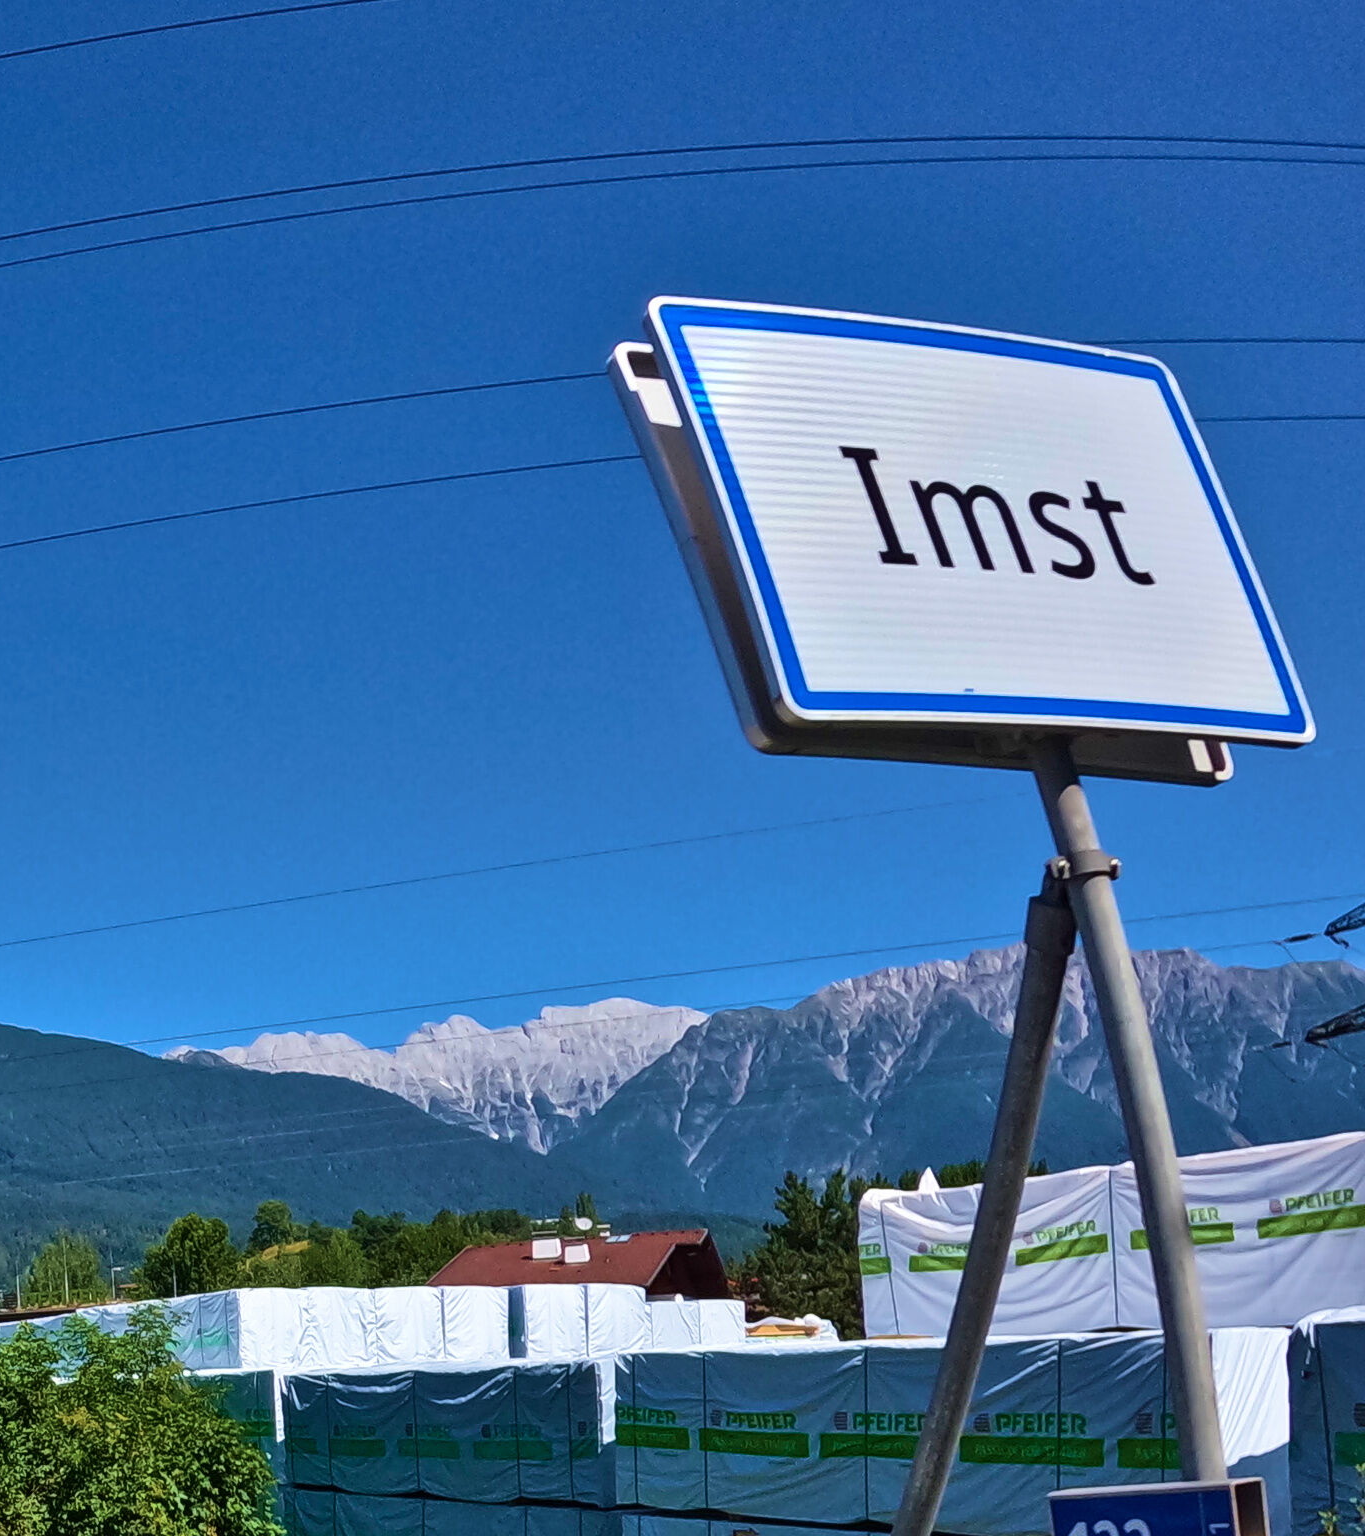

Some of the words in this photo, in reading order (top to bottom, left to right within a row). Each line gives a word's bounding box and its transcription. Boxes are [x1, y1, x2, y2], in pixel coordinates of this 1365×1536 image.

[839, 446, 1155, 586] Imst
[1286, 1188, 1354, 1212] PFEIFER
[725, 1411, 797, 1429] PFEIFER
[995, 1412, 1087, 1434] PFEIFER
